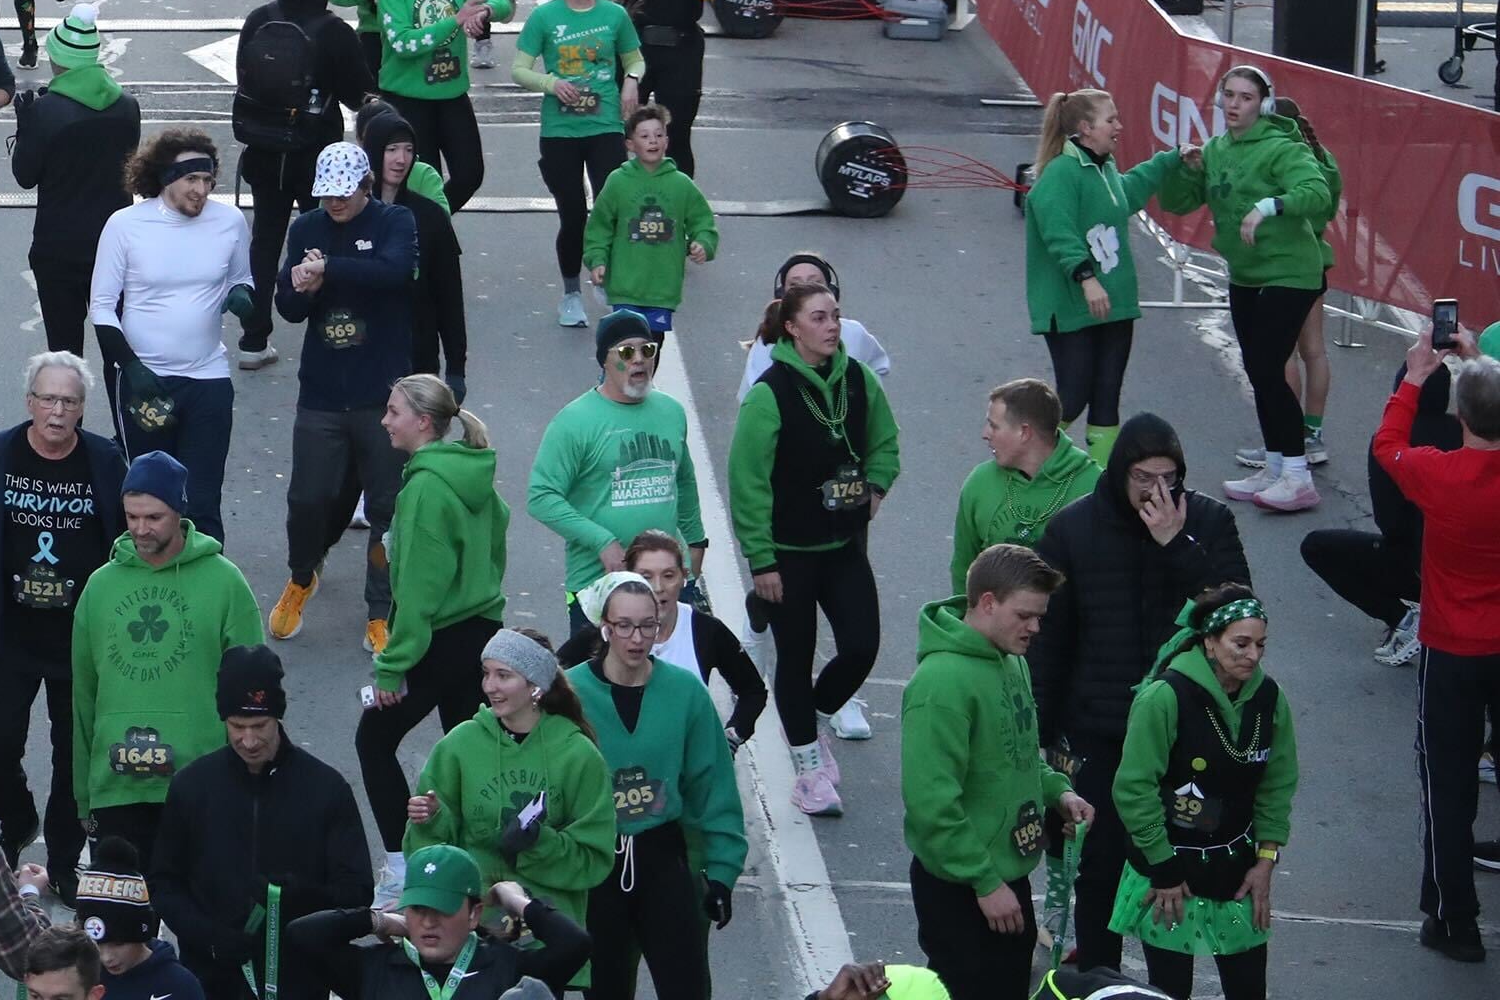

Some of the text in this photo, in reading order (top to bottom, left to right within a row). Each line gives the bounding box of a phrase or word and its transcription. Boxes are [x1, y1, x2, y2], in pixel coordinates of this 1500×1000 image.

[431, 60, 455, 75] 704
[838, 165, 891, 186] MYLAPS
[639, 221, 664, 233] 591
[324, 323, 356, 339] 569
[5, 473, 93, 496] THIS IS WHAT A
[612, 475, 673, 489] PITTSBURGH
[832, 481, 863, 498] 1745
[4, 488, 94, 515] SURVIVOR
[11, 511, 83, 529] LOOKS LIKE
[22, 580, 63, 597] 1521
[114, 586, 190, 616] PITTSBURGH
[107, 641, 187, 682] PARADE DAY DASH
[118, 748, 167, 765] 1643
[613, 785, 654, 808] 205
[1174, 796, 1203, 815] 39
